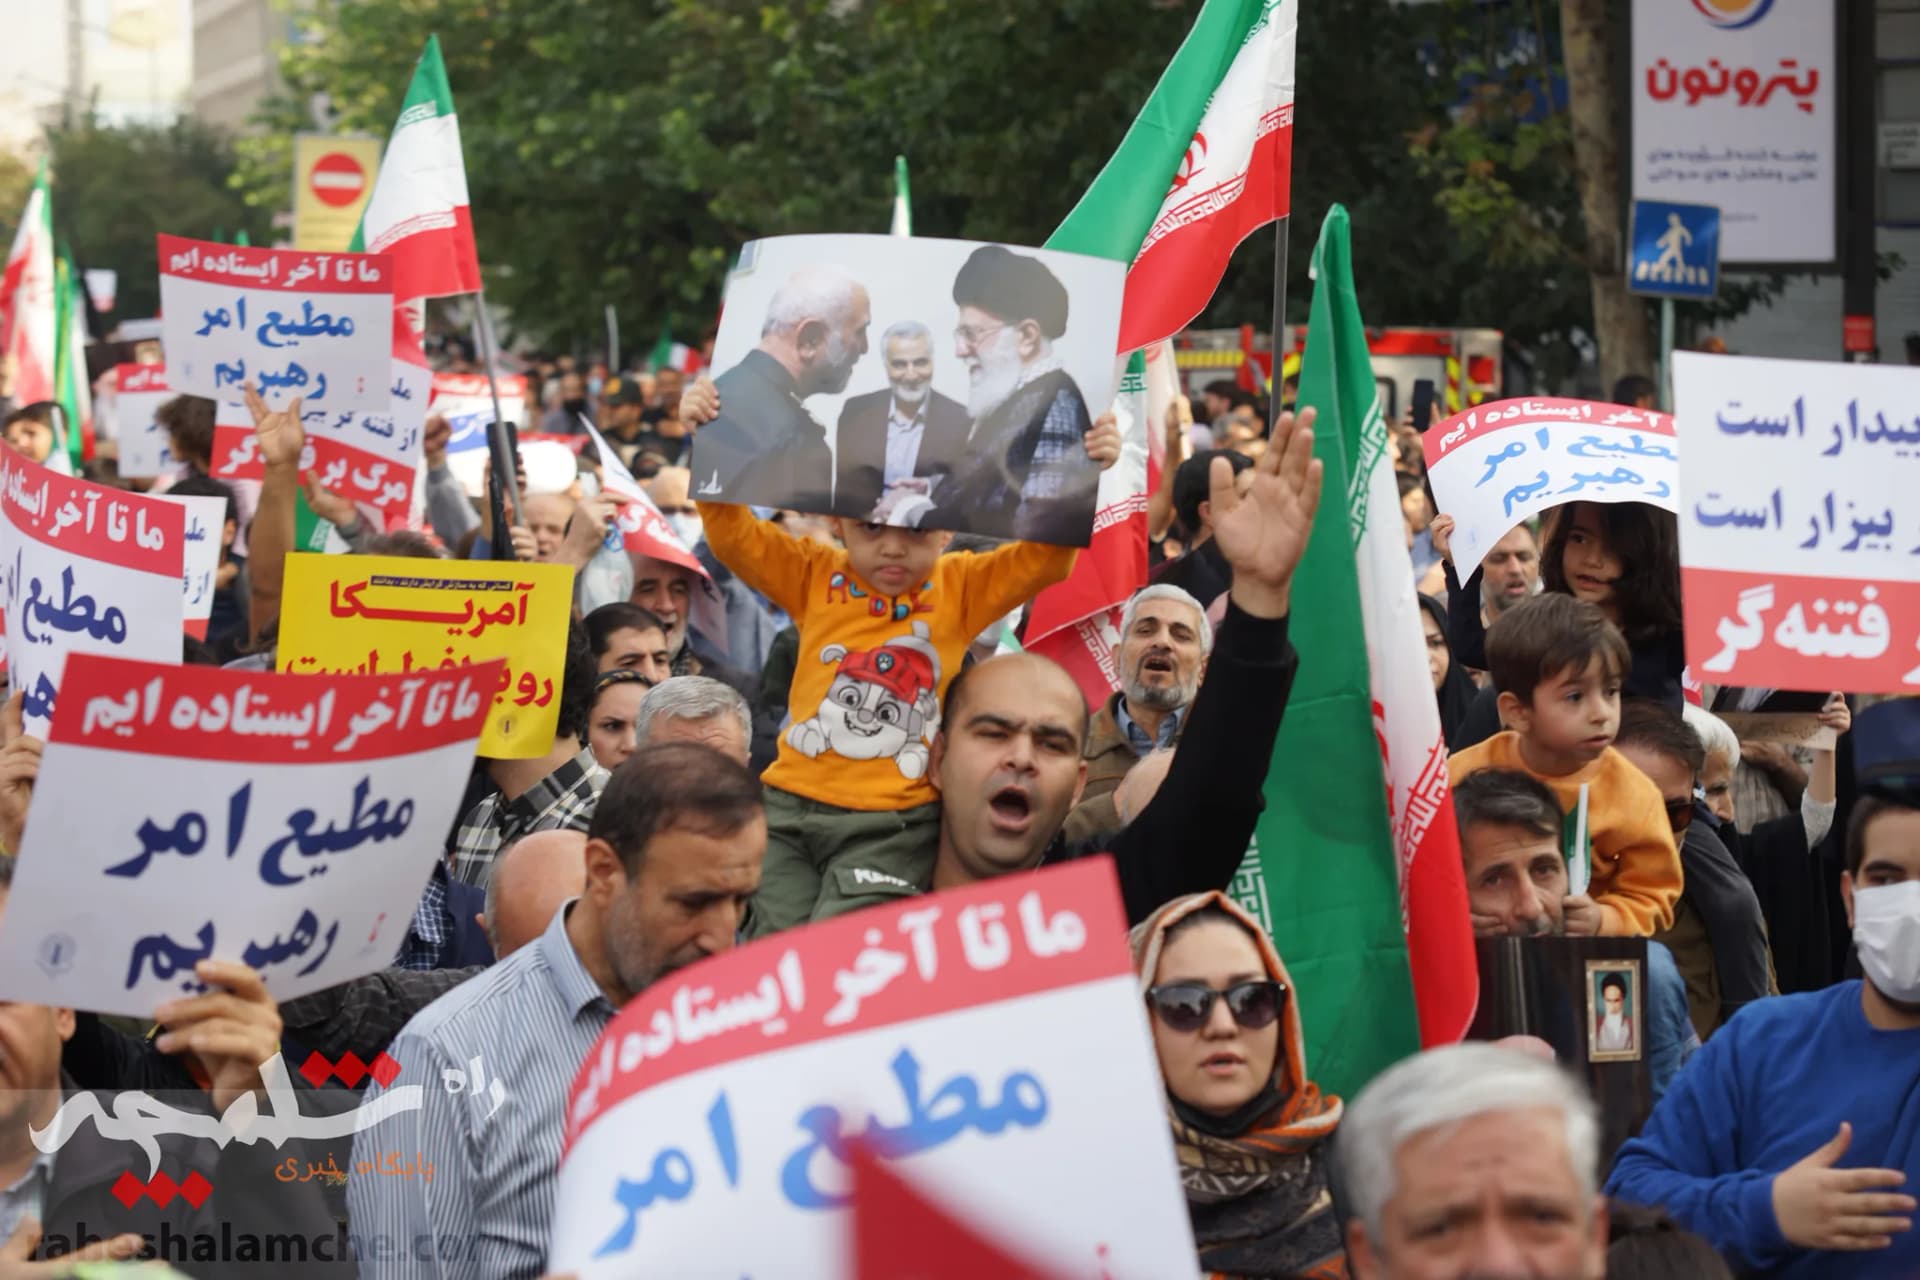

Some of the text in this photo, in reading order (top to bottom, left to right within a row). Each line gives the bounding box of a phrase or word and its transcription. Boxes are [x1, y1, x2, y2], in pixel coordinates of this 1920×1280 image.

[1646, 57, 1820, 115] پترونون
[170, 247, 381, 287] ما تا آخر ایستاده ایم
[194, 295, 356, 348] مطیع امر
[214, 357, 328, 400] رهبریم
[1439, 400, 1664, 454] آخر ایستاده ایم
[1715, 395, 1806, 438] است
[319, 457, 348, 490] بر
[351, 461, 408, 506] مرگ
[1474, 426, 1550, 489] امر
[47, 488, 103, 538] آخر
[1502, 465, 1671, 518] رهبریم
[1694, 487, 1783, 531] است
[106, 500, 129, 543] تا
[135, 506, 165, 551] ما
[1799, 490, 1894, 552] بیزار
[22, 564, 128, 645] مطیع
[329, 580, 536, 639] آمریکا
[81, 675, 165, 738] ایم
[169, 682, 337, 750] ایستاده
[332, 677, 426, 753] آخر
[421, 680, 455, 728] تا
[451, 675, 481, 721] ما
[101, 773, 416, 887] مطیع امر
[125, 907, 340, 992] رهبریم
[956, 902, 1014, 973] تا
[1019, 890, 1088, 960] ما
[822, 905, 943, 1028] آخر
[618, 946, 806, 1074] ایستاده
[591, 1087, 742, 1261] امر
